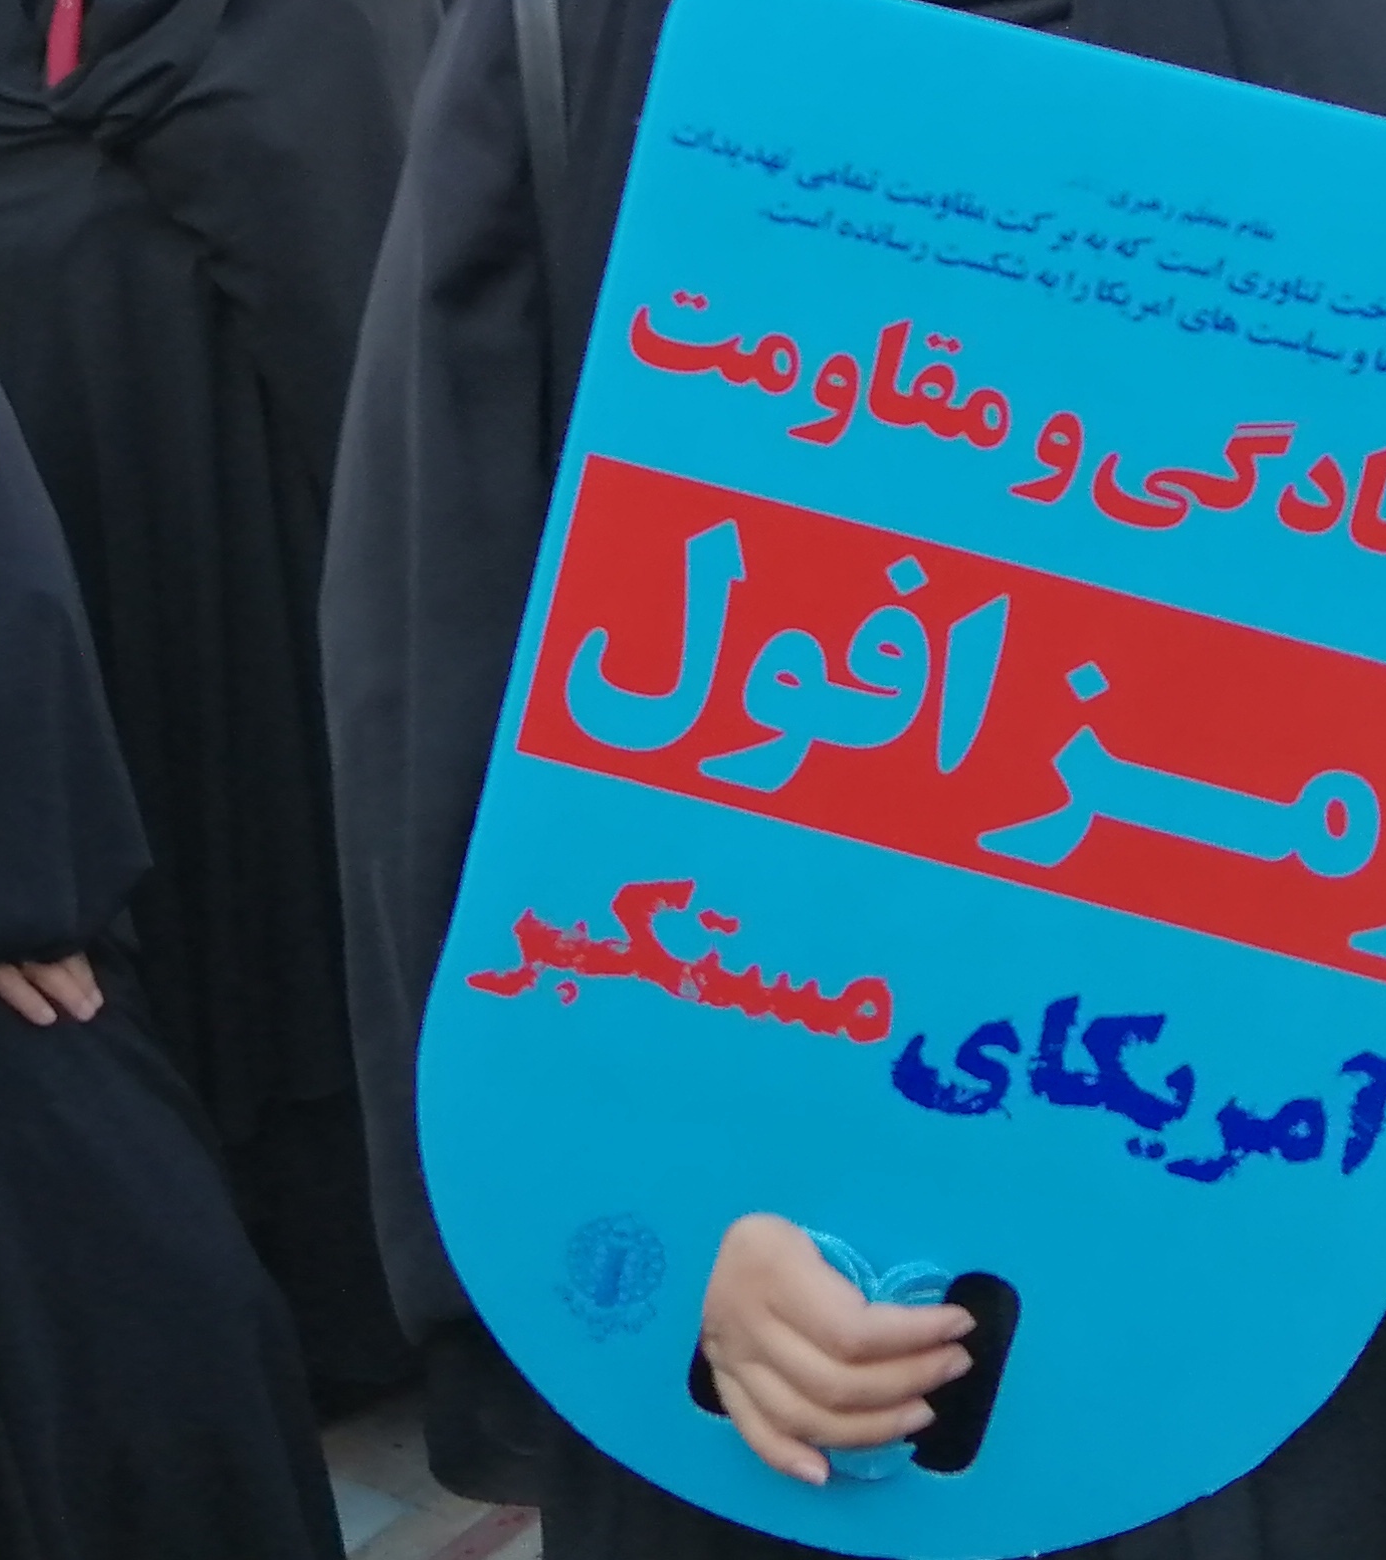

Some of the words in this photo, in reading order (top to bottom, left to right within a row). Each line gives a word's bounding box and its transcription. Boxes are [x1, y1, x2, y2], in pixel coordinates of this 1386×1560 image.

[671, 127, 790, 176] تهدیدات
[795, 165, 877, 193] تمامی
[884, 184, 987, 222] مقاومت
[837, 221, 928, 262] رسانده
[1083, 233, 1108, 251] به
[1114, 237, 1153, 258] که
[934, 246, 1029, 281] شکست
[1034, 271, 1060, 289] به
[1156, 252, 1225, 278] است
[1066, 272, 1090, 303] را
[1178, 307, 1239, 335] های
[1246, 325, 1345, 362] سیاست
[628, 288, 1011, 450] مقاومت
[1349, 350, 1368, 375] و
[1010, 410, 1083, 502] و
[565, 518, 1010, 793] افول
[466, 878, 894, 1043] مستکبر
